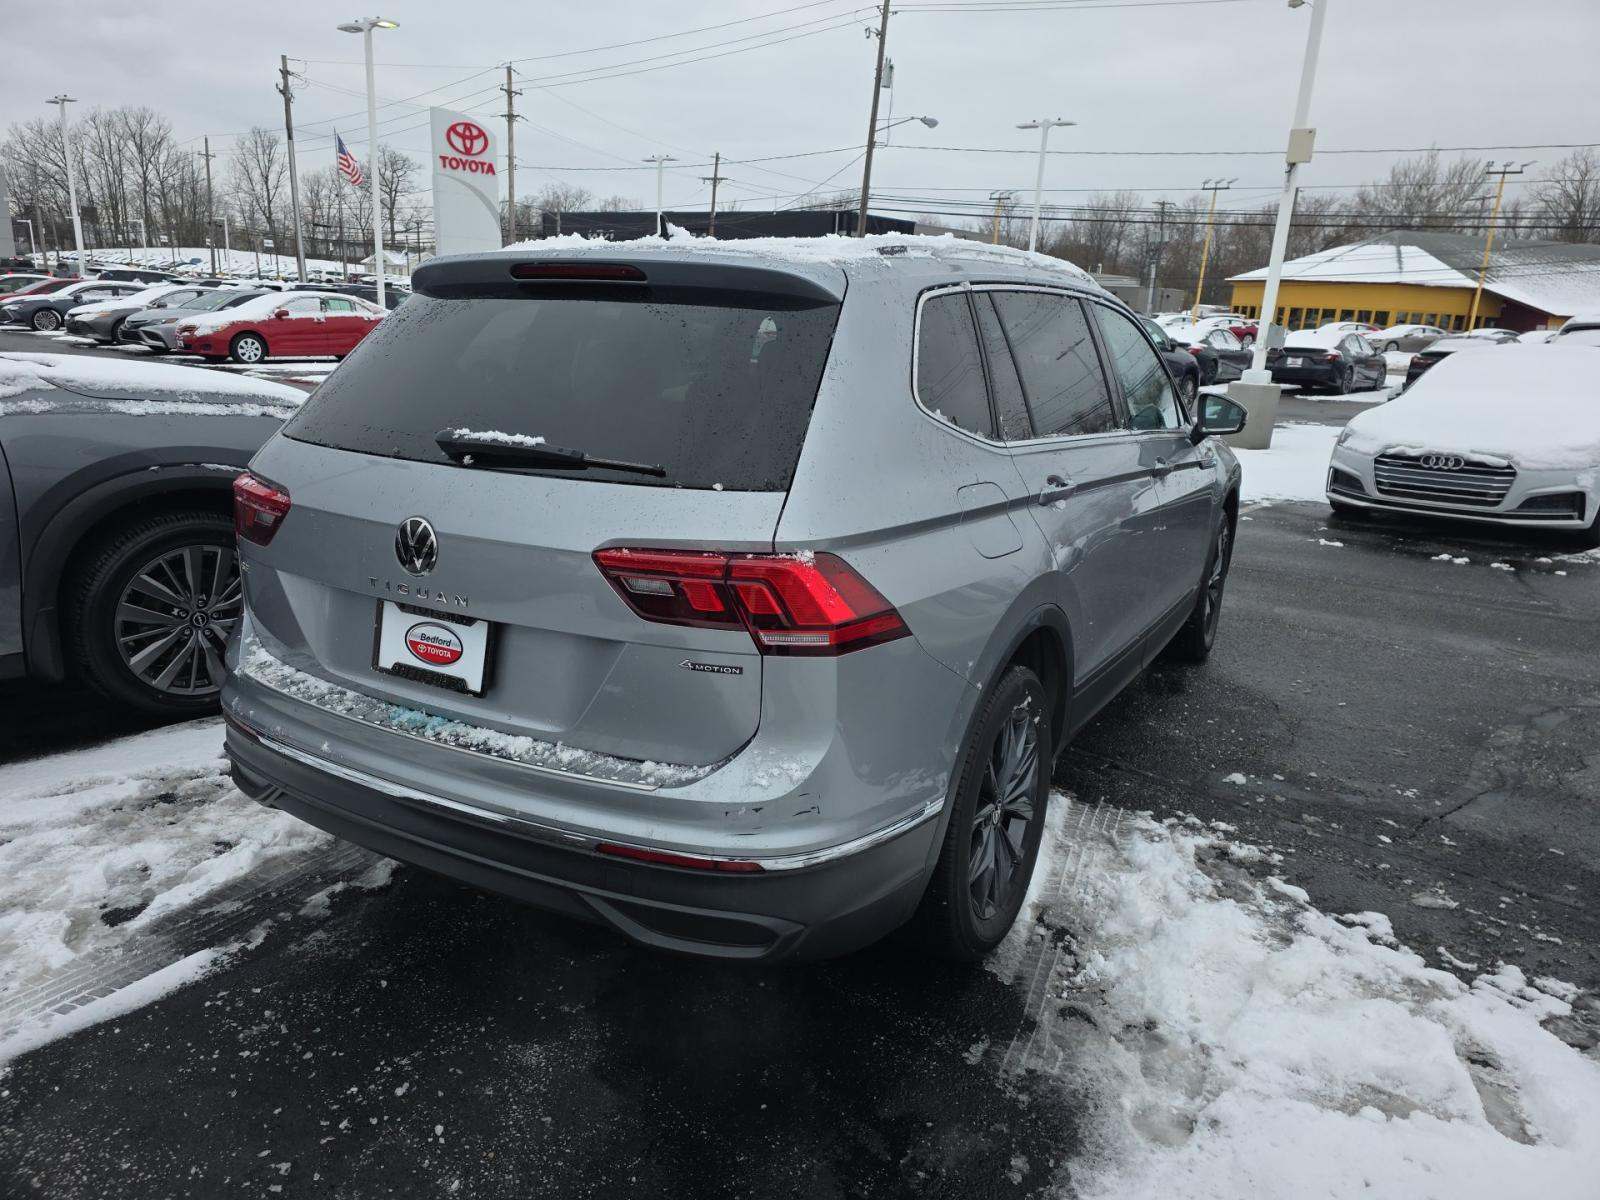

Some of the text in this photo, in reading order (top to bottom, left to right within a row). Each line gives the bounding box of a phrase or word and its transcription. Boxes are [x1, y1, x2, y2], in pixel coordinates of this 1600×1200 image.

[439, 156, 496, 175] TOYOTA
[368, 577, 469, 608] TIGUAN
[420, 633, 452, 647] Bedford
[427, 646, 451, 658] TOYOTA
[678, 659, 741, 674] 4MOTION
